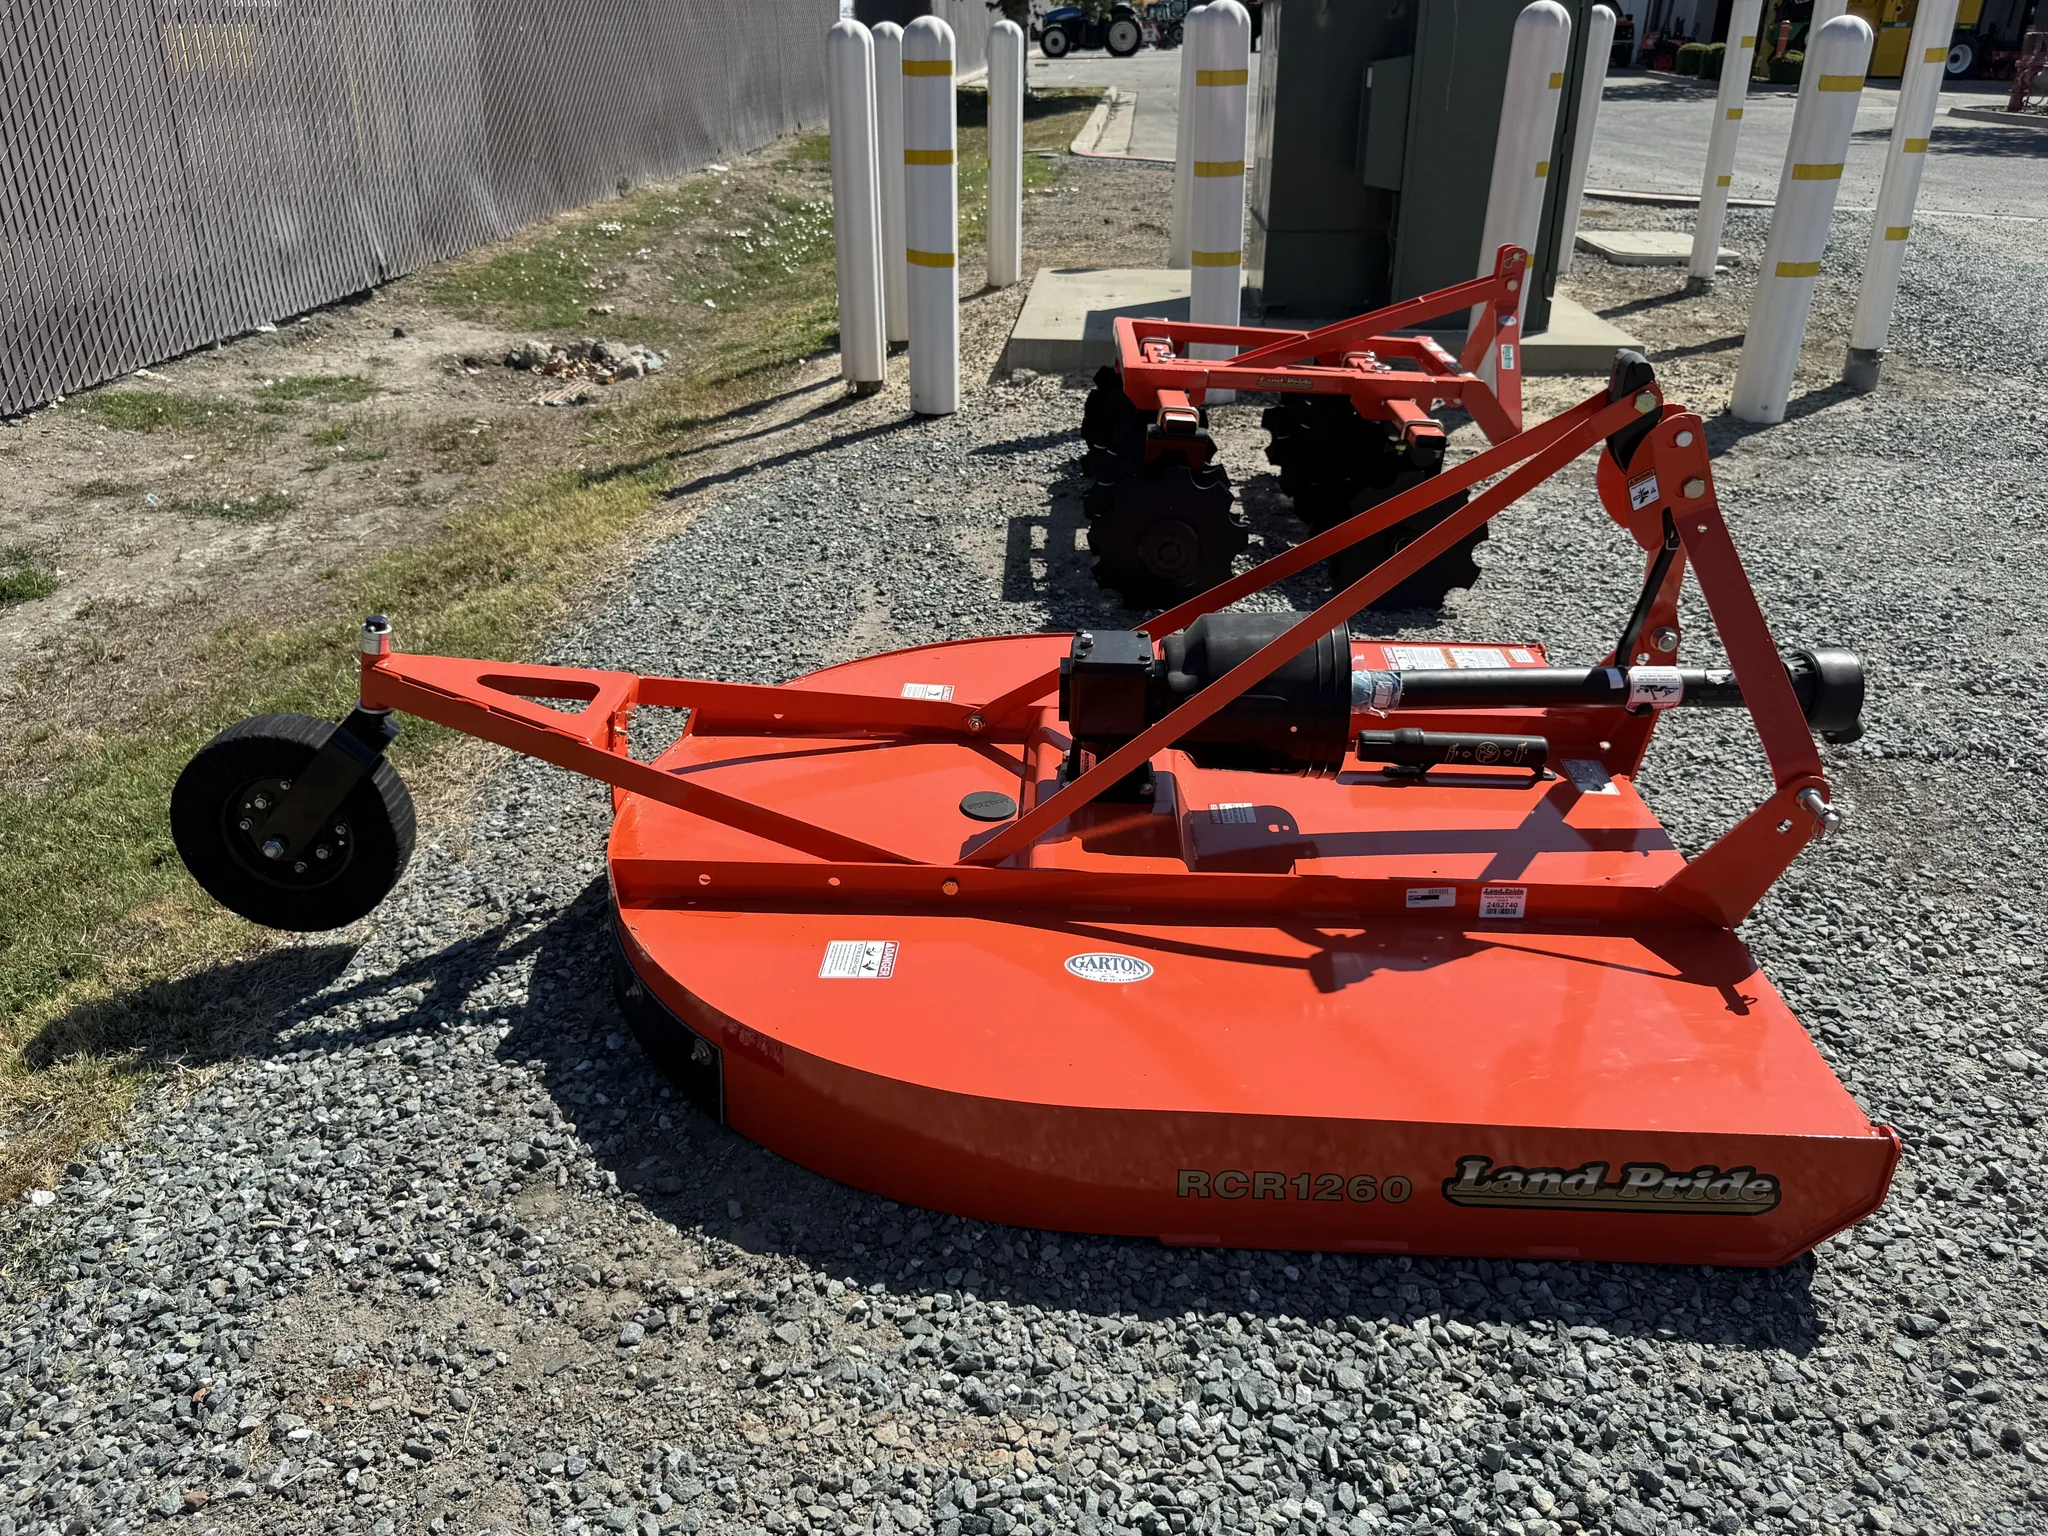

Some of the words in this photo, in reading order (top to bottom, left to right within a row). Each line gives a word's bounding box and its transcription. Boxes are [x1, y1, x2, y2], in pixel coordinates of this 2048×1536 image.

[879, 946, 897, 976] DANGER
[1071, 956, 1145, 973] GARTON
[1177, 1169, 1413, 1203] RCR1260
[1453, 1159, 1605, 1197] Land
[1615, 1166, 1774, 1202] Pride
